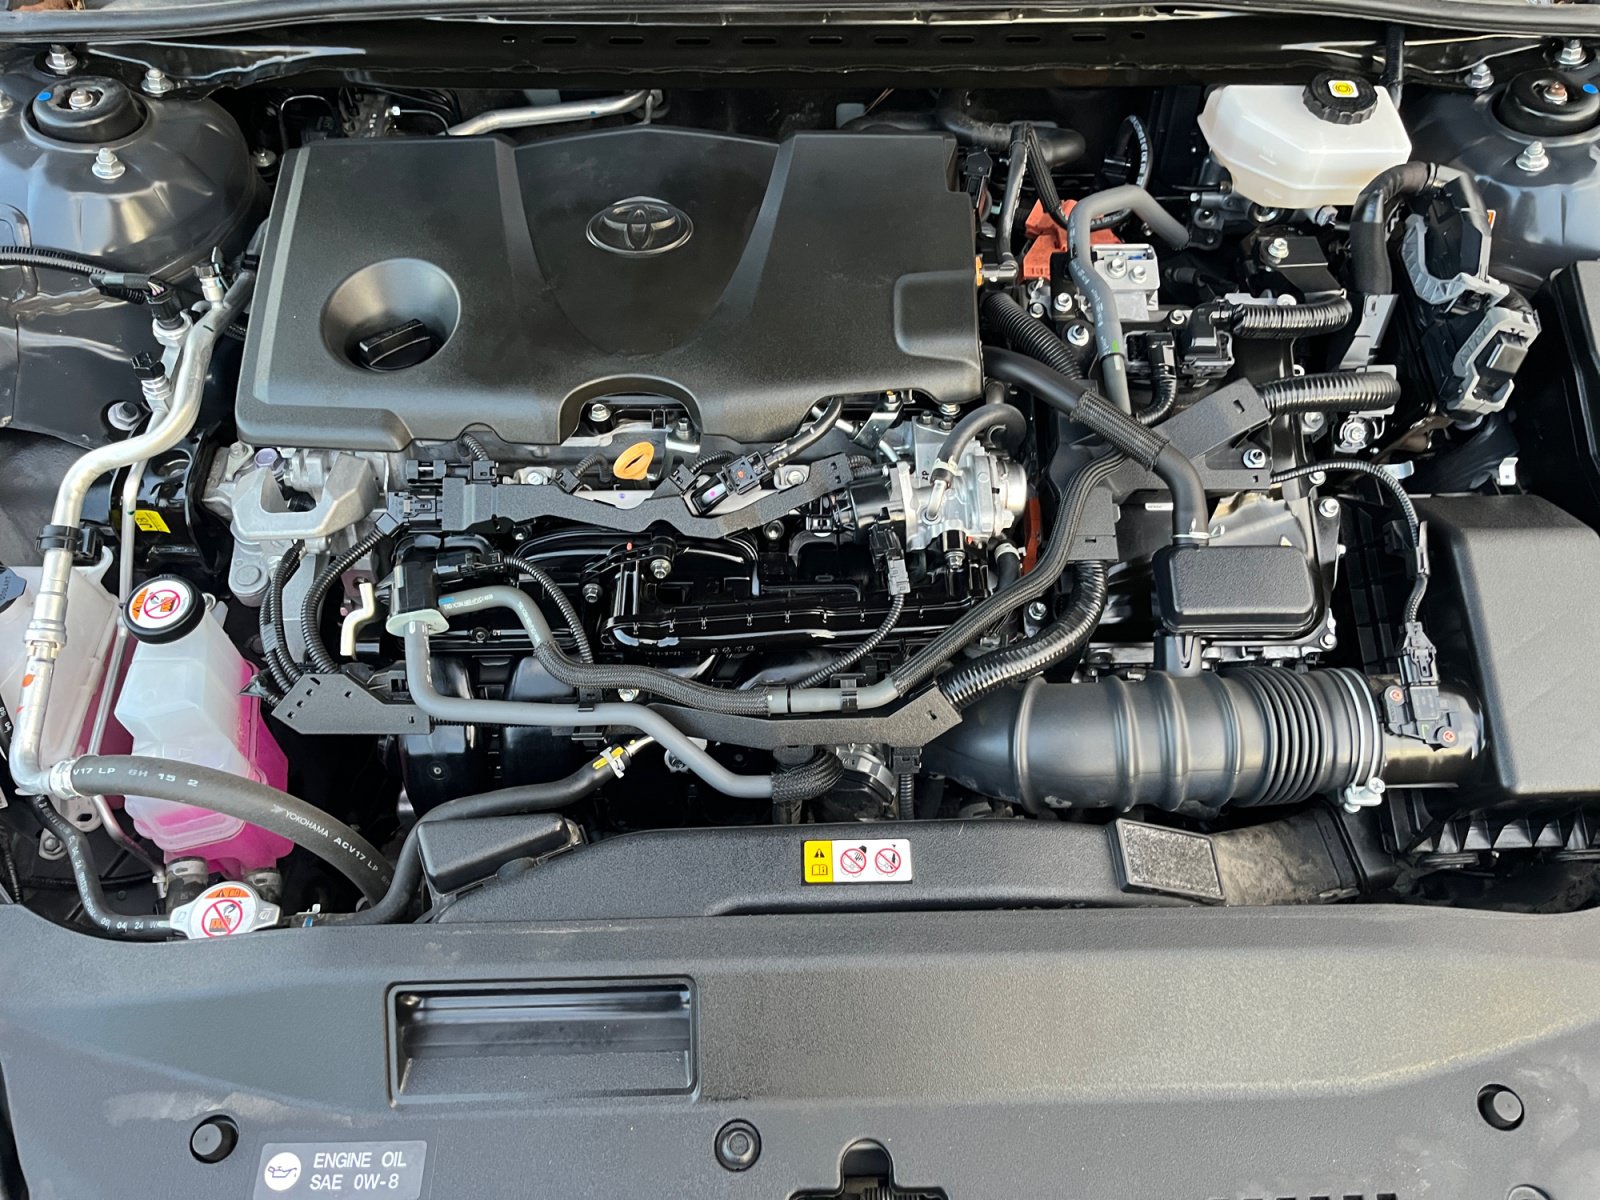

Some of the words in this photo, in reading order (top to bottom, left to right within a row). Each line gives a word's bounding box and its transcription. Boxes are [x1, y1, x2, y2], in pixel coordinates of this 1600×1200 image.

[158, 773, 176, 782] 15
[187, 779, 199, 787] 2
[284, 810, 329, 838] YOKOHAMA
[333, 837, 366, 861] ACV17
[367, 860, 379, 871] LP
[134, 921, 144, 930] 24
[313, 1152, 372, 1168] ENGINE
[381, 1151, 407, 1167] OIL
[309, 1174, 343, 1190] SAE
[353, 1173, 400, 1189] 0W-8
